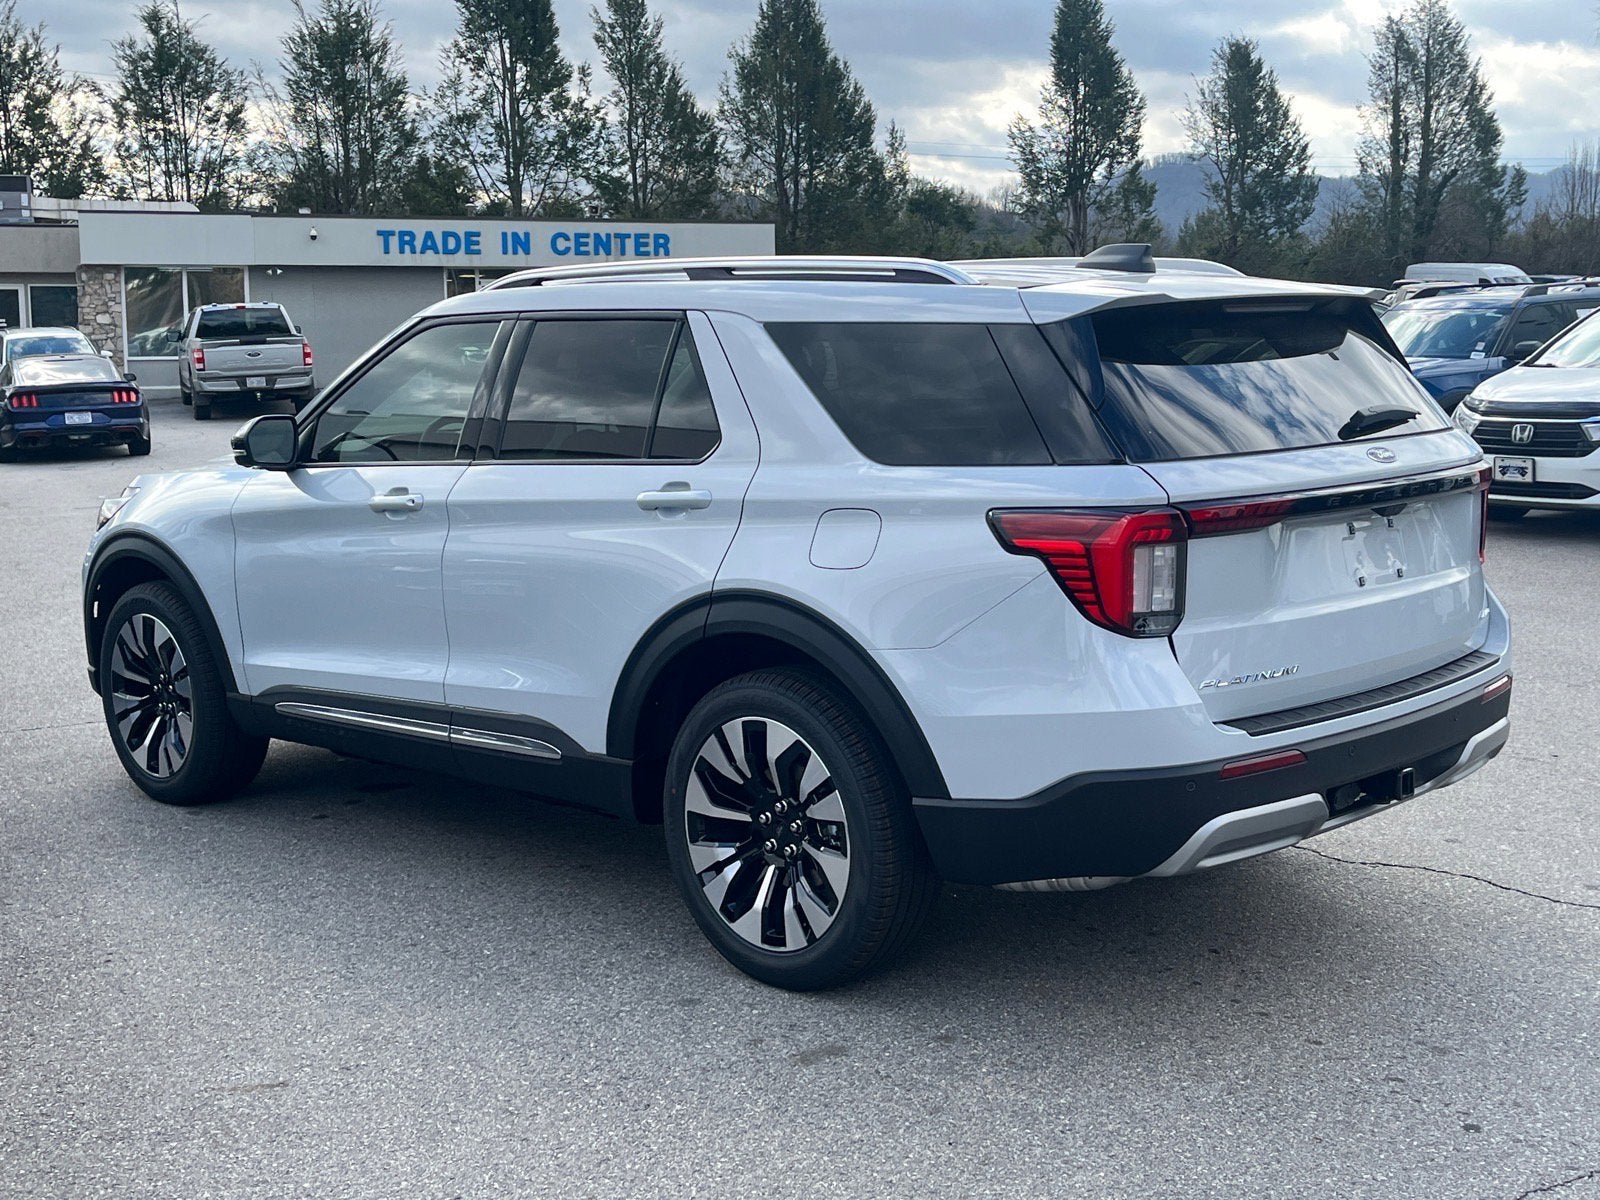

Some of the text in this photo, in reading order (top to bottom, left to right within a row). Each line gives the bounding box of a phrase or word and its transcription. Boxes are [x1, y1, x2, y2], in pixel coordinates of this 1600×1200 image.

[376, 229, 671, 257] TRADE IN CENTER
[1198, 664, 1300, 690] PLATINUM
